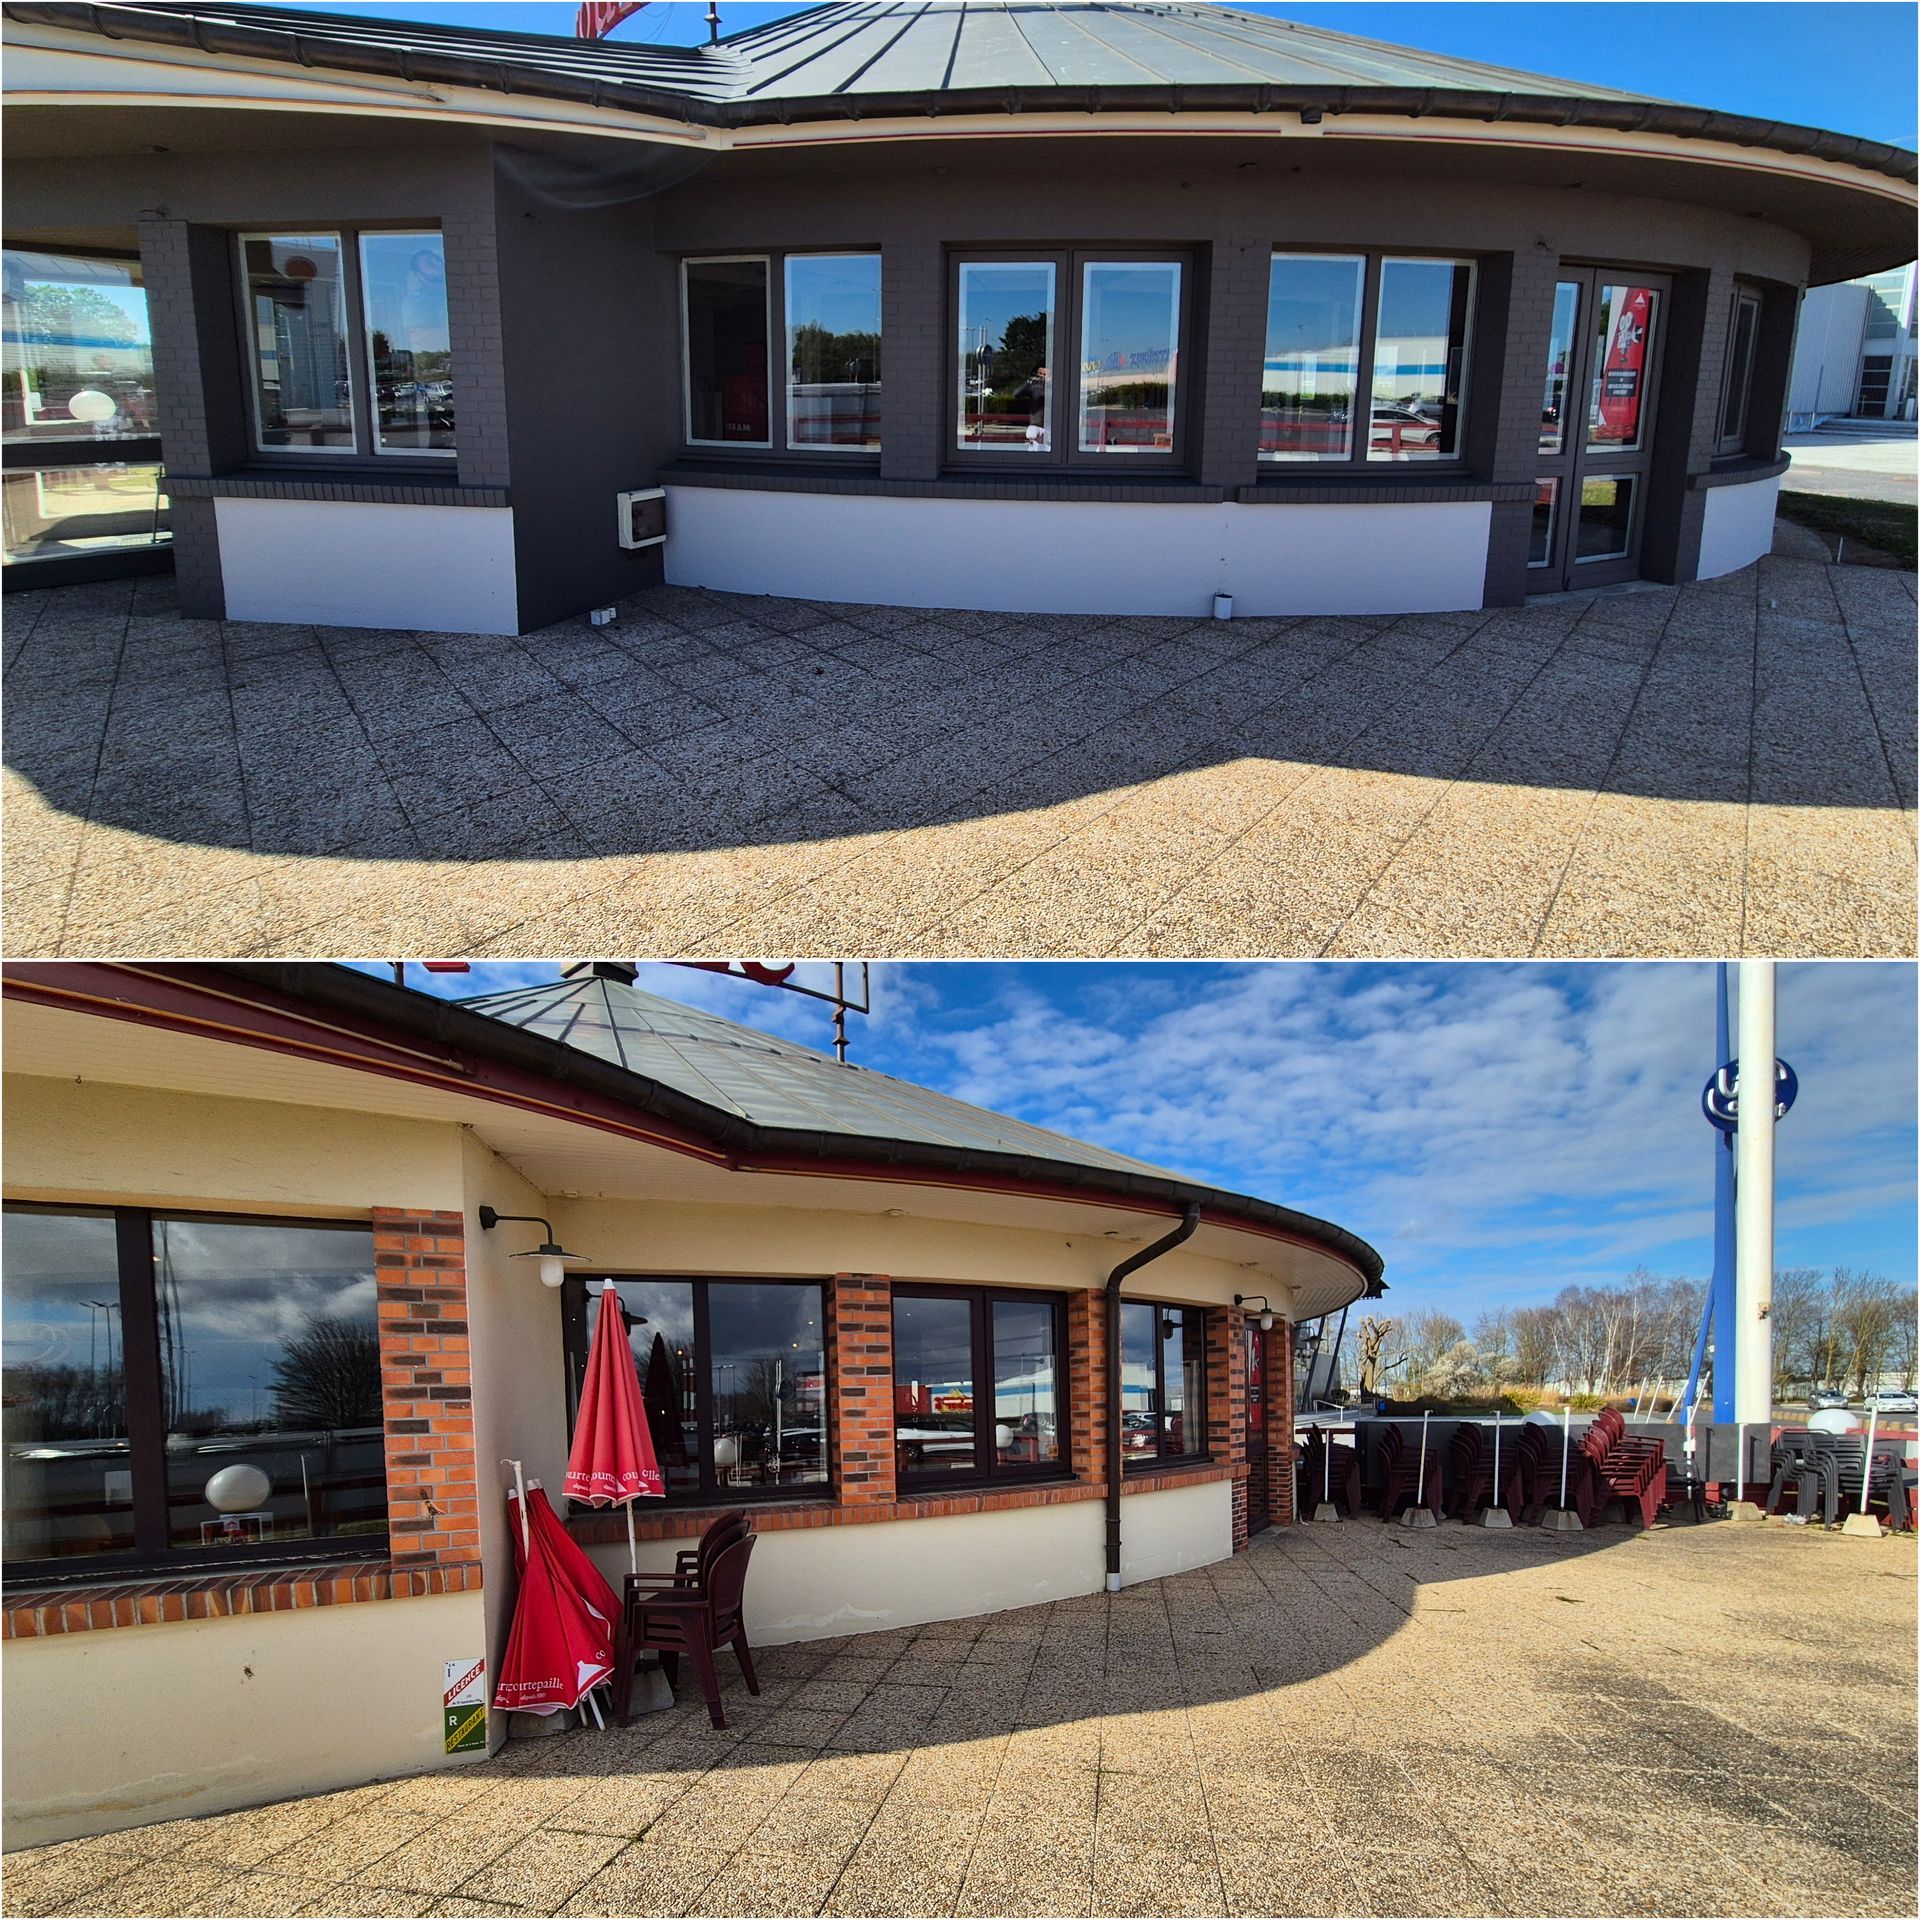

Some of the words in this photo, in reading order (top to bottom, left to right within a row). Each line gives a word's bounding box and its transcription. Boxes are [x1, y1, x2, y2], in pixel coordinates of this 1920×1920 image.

[448, 1664, 481, 1701] LICENCE
[446, 1707, 484, 1749] RESTAURANT
[449, 1715, 458, 1727] R
